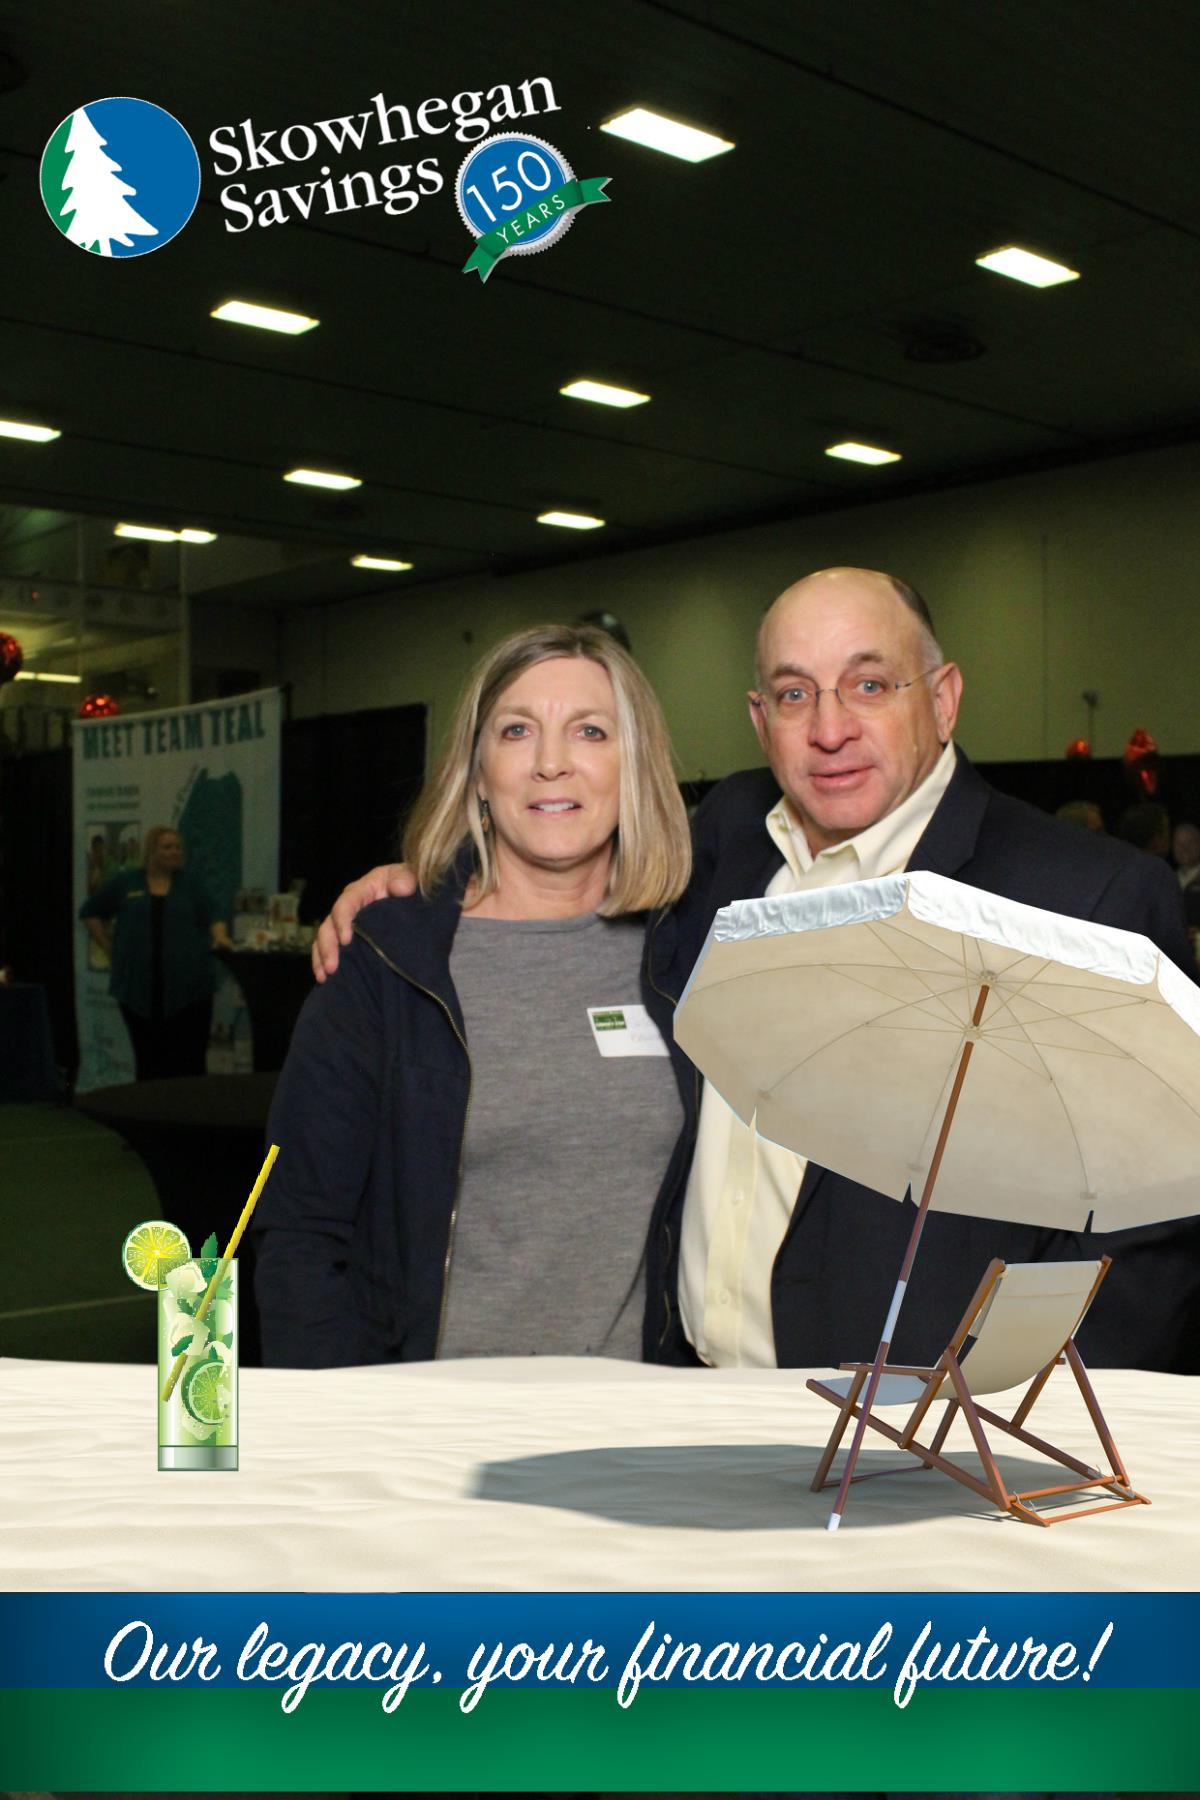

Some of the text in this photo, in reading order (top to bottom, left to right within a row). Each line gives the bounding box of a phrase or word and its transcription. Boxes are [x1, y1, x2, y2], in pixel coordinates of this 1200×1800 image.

[83, 701, 265, 759] MEET TEAM TEAL
